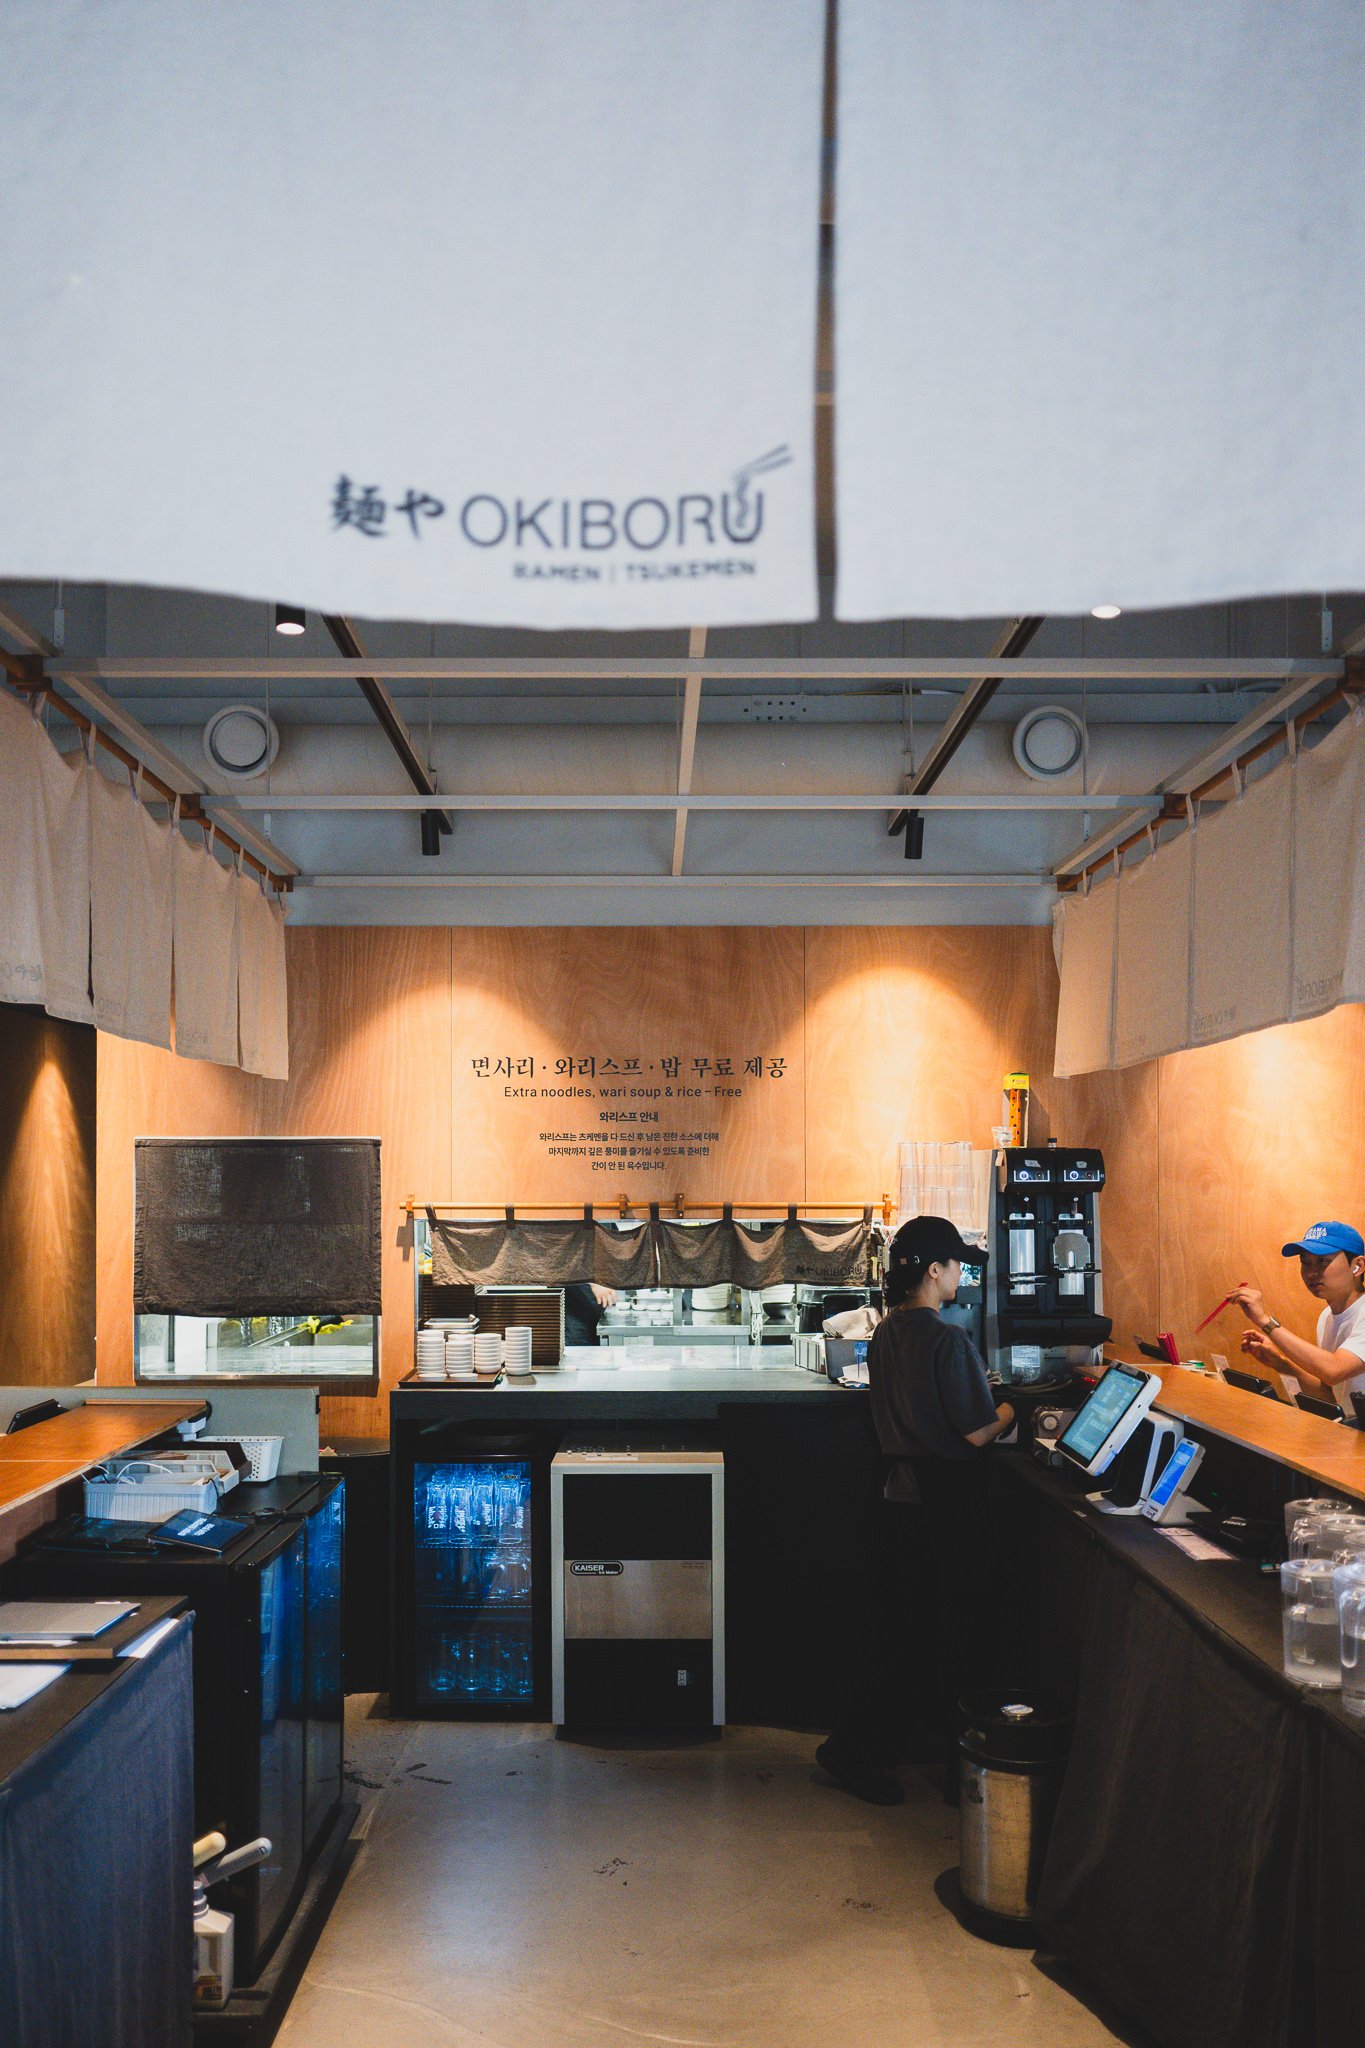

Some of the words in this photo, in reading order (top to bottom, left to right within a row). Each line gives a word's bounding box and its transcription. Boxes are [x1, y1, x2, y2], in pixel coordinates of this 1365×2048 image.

[459, 488, 766, 551] OKIBORU
[512, 561, 601, 582] RAMEN
[625, 558, 757, 580] TSUKEMEN
[471, 1056, 534, 1079] 면사리
[554, 1056, 643, 1079] 와리스프
[660, 1056, 682, 1079] 밥
[691, 1058, 735, 1079] 무료
[743, 1056, 788, 1079] 제공
[504, 1086, 537, 1098] Extra
[541, 1086, 596, 1099] noodles,
[600, 1086, 626, 1098] wari
[630, 1088, 661, 1100] soup
[665, 1086, 674, 1098] &
[677, 1086, 702, 1098] rice
[714, 1086, 742, 1098] Free
[599, 1111, 638, 1123] 와리스프
[639, 1111, 659, 1123] 안내
[539, 1132, 577, 1142] 와리스프는
[610, 1132, 619, 1142] 다
[619, 1132, 635, 1142] 드신
[636, 1132, 644, 1142] 후
[645, 1132, 661, 1142] 남은
[679, 1132, 703, 1142] 소스에
[548, 1146, 587, 1156] 마지막까지
[653, 1146, 661, 1156] 수
[608, 1161, 616, 1171] 안
[574, 1564, 605, 1572] KAISER
